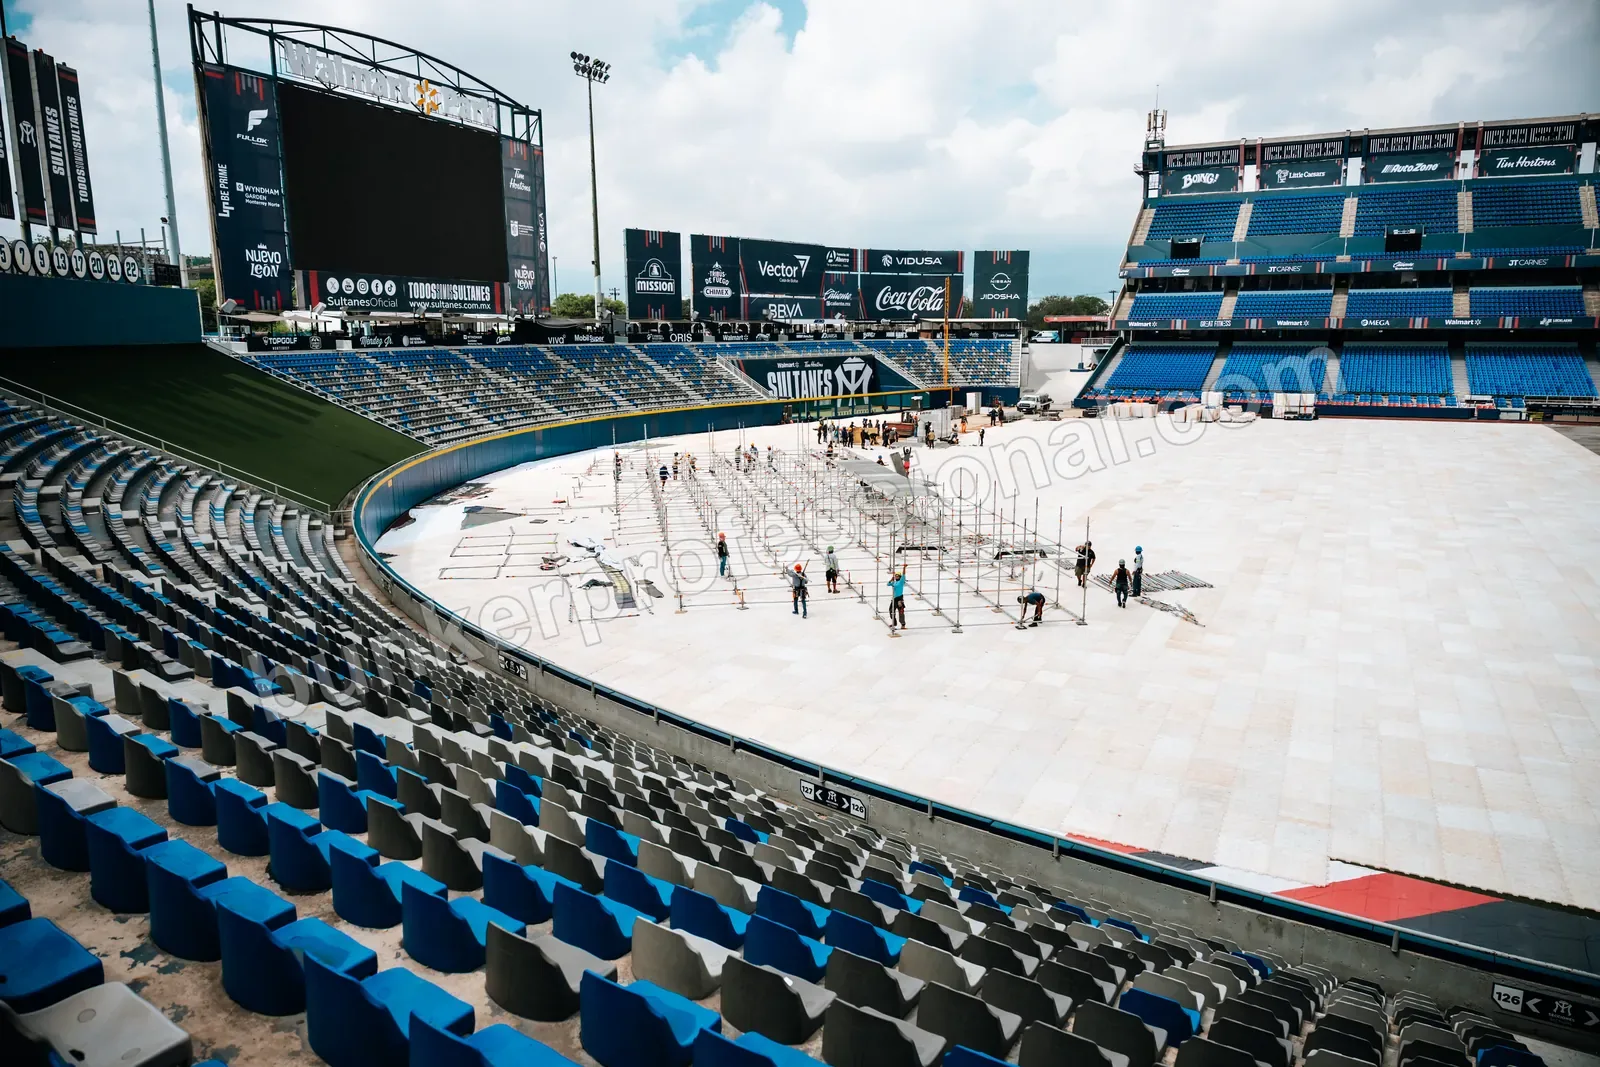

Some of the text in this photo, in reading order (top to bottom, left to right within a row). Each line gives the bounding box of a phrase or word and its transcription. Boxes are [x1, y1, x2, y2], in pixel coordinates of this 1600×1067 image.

[283, 39, 411, 105] Walmart
[45, 106, 65, 176] SULTANES
[1390, 162, 1439, 173] AutoZone
[1496, 155, 1557, 169] Tim Hortons
[513, 167, 525, 180] Tim
[217, 163, 230, 201] BE PRIME
[509, 178, 531, 192] Hortons
[1181, 173, 1219, 190] BOING!
[244, 184, 279, 196] WYNDHAM
[245, 193, 267, 201] GARDEN
[19, 247, 25, 265] 7
[38, 250, 44, 267] 9
[55, 252, 66, 270] 13
[895, 257, 941, 265] VIDUSA
[1519, 258, 1547, 266] CARNES
[73, 255, 83, 272] 17
[91, 257, 102, 274] 20
[109, 259, 119, 275] 21
[126, 261, 137, 277] 22
[758, 260, 798, 278] Vector
[1276, 265, 1300, 273] CARNES
[637, 280, 674, 292] MISSION
[823, 288, 851, 301] Caliente
[875, 285, 945, 311] Coca-Cola
[409, 300, 491, 310] www.sultanes.com.mx
[769, 303, 803, 319] BBVA
[574, 334, 589, 342] Mobil
[670, 333, 693, 342] ORIS
[767, 369, 833, 405] SULTANES
[802, 786, 812, 794] 127
[852, 803, 864, 813] 126
[1496, 992, 1520, 1005] 126
